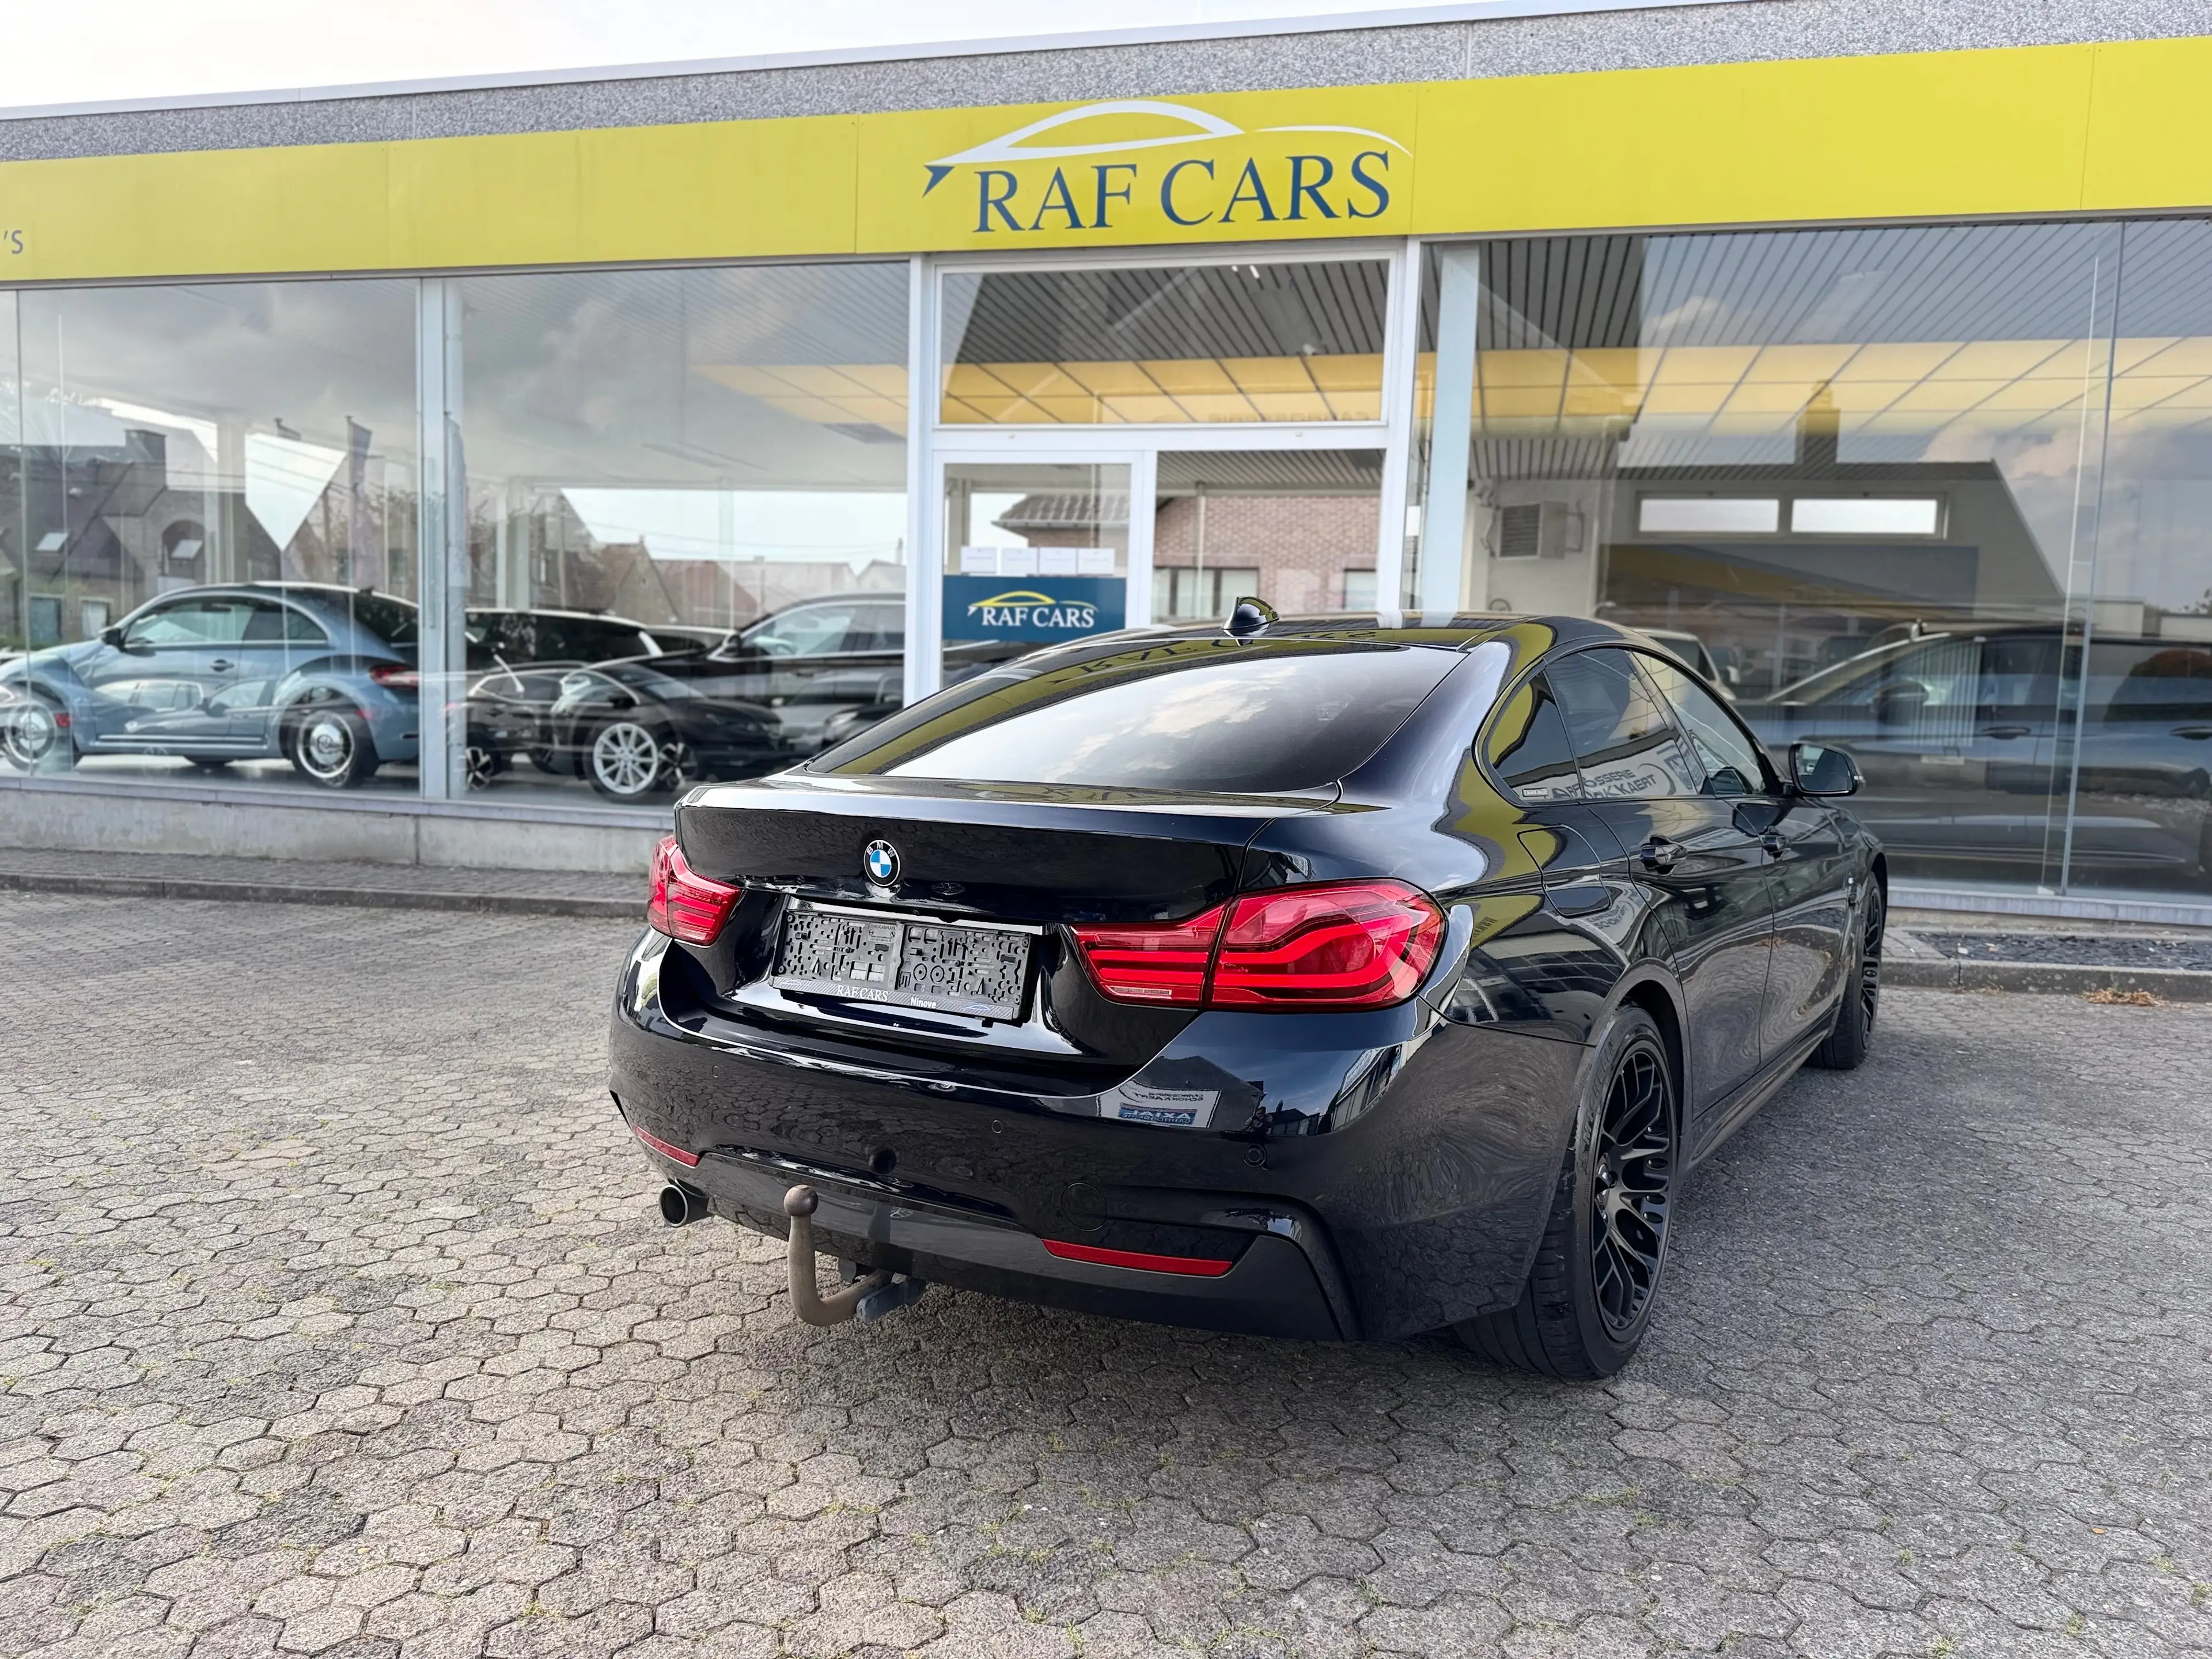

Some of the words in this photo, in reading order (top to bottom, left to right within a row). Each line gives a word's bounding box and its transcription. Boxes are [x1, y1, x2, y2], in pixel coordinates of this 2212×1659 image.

[972, 164, 1137, 233] RAF
[1160, 150, 1390, 226] CARS
[982, 607, 1029, 626] RAF
[1032, 608, 1095, 628] CARS
[866, 842, 895, 857] BMW
[838, 984, 859, 997] RAF
[859, 987, 889, 1002] CARS
[910, 997, 937, 1009] Ninove
